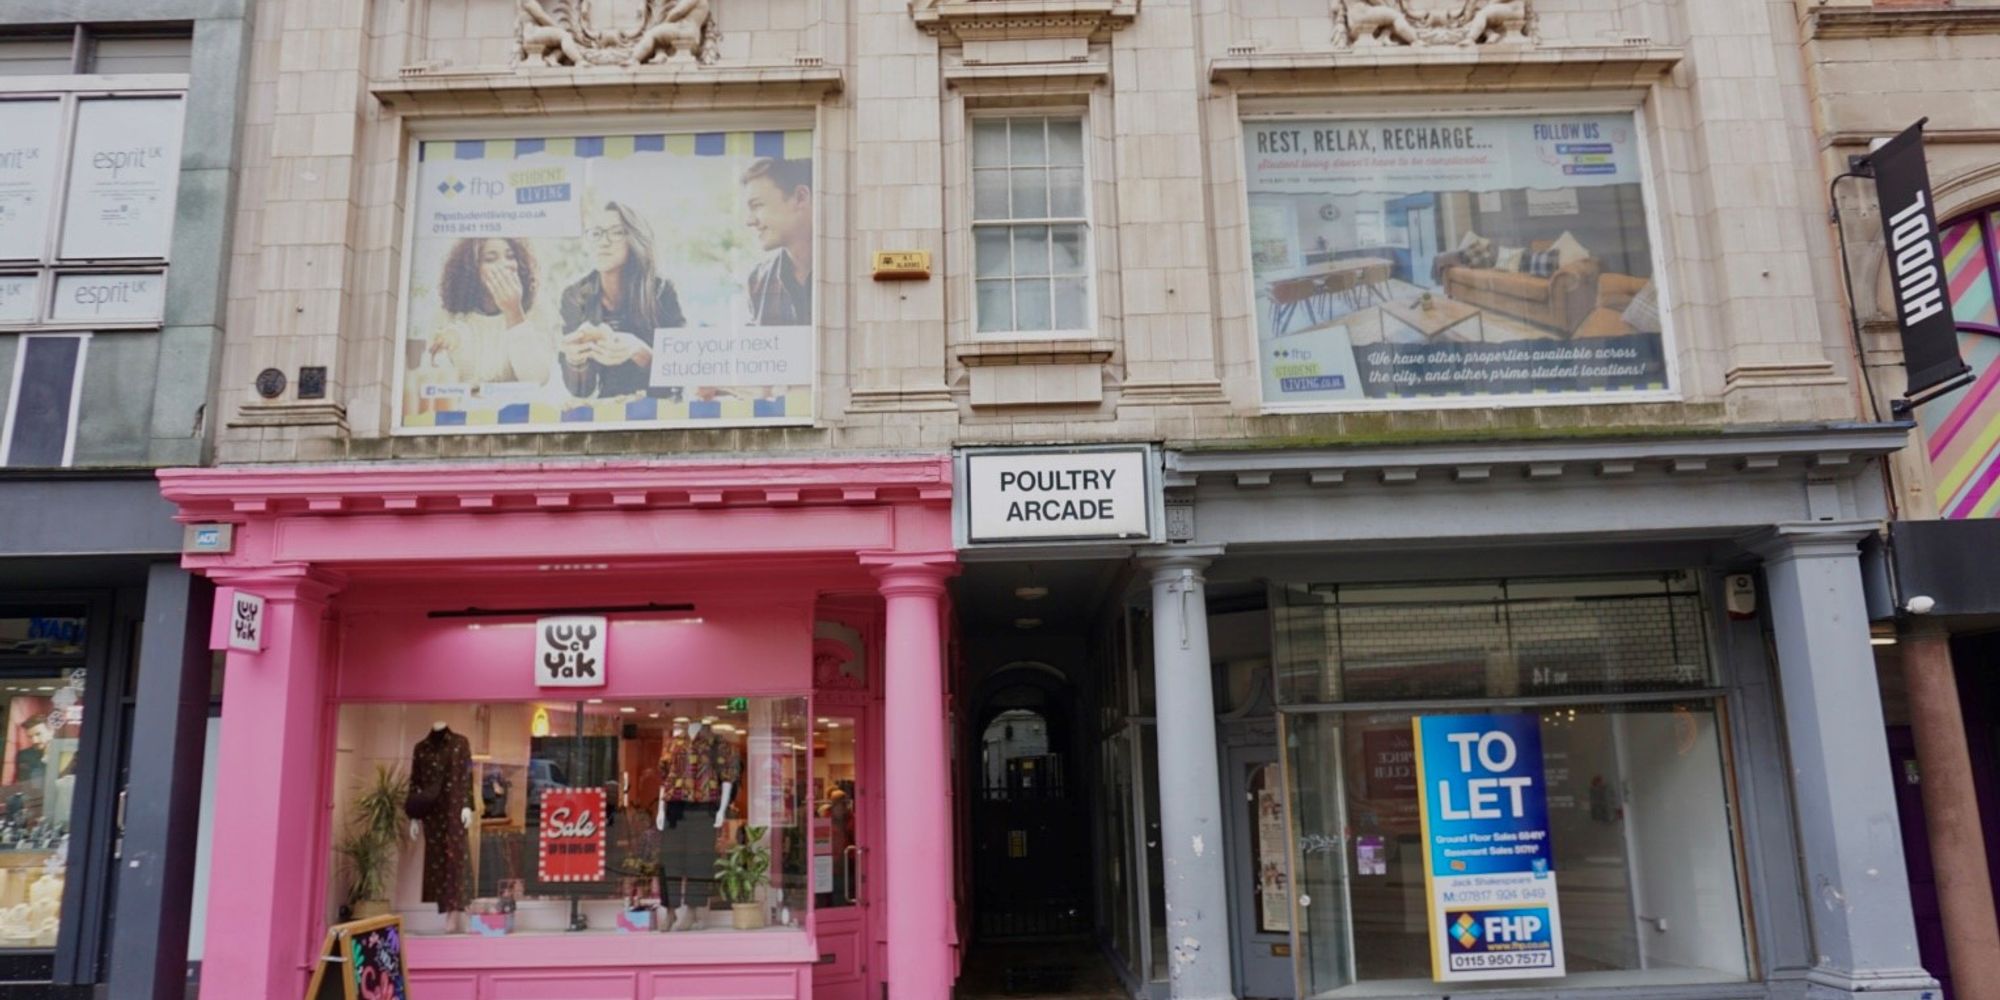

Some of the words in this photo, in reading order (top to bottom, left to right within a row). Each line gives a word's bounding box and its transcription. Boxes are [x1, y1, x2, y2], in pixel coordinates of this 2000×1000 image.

[1257, 130, 1307, 155] REST,
[1313, 129, 1376, 153] RELAX,
[1383, 127, 1493, 151] RECHARGE...
[1534, 123, 1582, 140] FOLLOW
[1583, 122, 1600, 139] US
[93, 149, 145, 179] esprit
[469, 176, 505, 200] fhp
[519, 185, 565, 202] LIVING
[433, 222, 457, 234] 0115
[1889, 190, 1944, 327] HUDDL
[75, 281, 129, 314] esprit
[132, 280, 147, 293] UK
[662, 337, 692, 354] For
[698, 338, 737, 356] your
[741, 335, 780, 351] next
[1290, 349, 1312, 361] fhp
[1367, 351, 1392, 366] We
[1393, 351, 1425, 365] have
[1427, 350, 1462, 364] other
[1463, 349, 1530, 365] properties
[1532, 347, 1592, 361] available
[1595, 347, 1638, 359] across
[662, 360, 731, 377] student
[736, 358, 787, 375] home
[1368, 370, 1390, 384] the
[1393, 370, 1422, 386] city,
[1424, 368, 1452, 382] and
[1453, 367, 1488, 381] other
[1489, 367, 1530, 383] prime
[1530, 365, 1580, 378] student
[1581, 362, 1646, 376] locations!
[1000, 469, 1117, 492] POULTRY
[1006, 499, 1115, 522] ARCADE
[1447, 731, 1517, 773] TO
[1438, 777, 1533, 821] LET
[547, 807, 597, 838] Sale
[1436, 834, 1468, 844] Ground
[1469, 833, 1492, 843] Floor
[1493, 831, 1517, 842] Sales
[1444, 847, 1488, 857] Basement
[1489, 845, 1514, 856] Sales
[1452, 879, 1472, 887] Jack
[1484, 915, 1542, 943] FHP
[1455, 955, 1485, 967] 0115
[1488, 954, 1514, 966] 950
[1517, 953, 1547, 965] 7577
